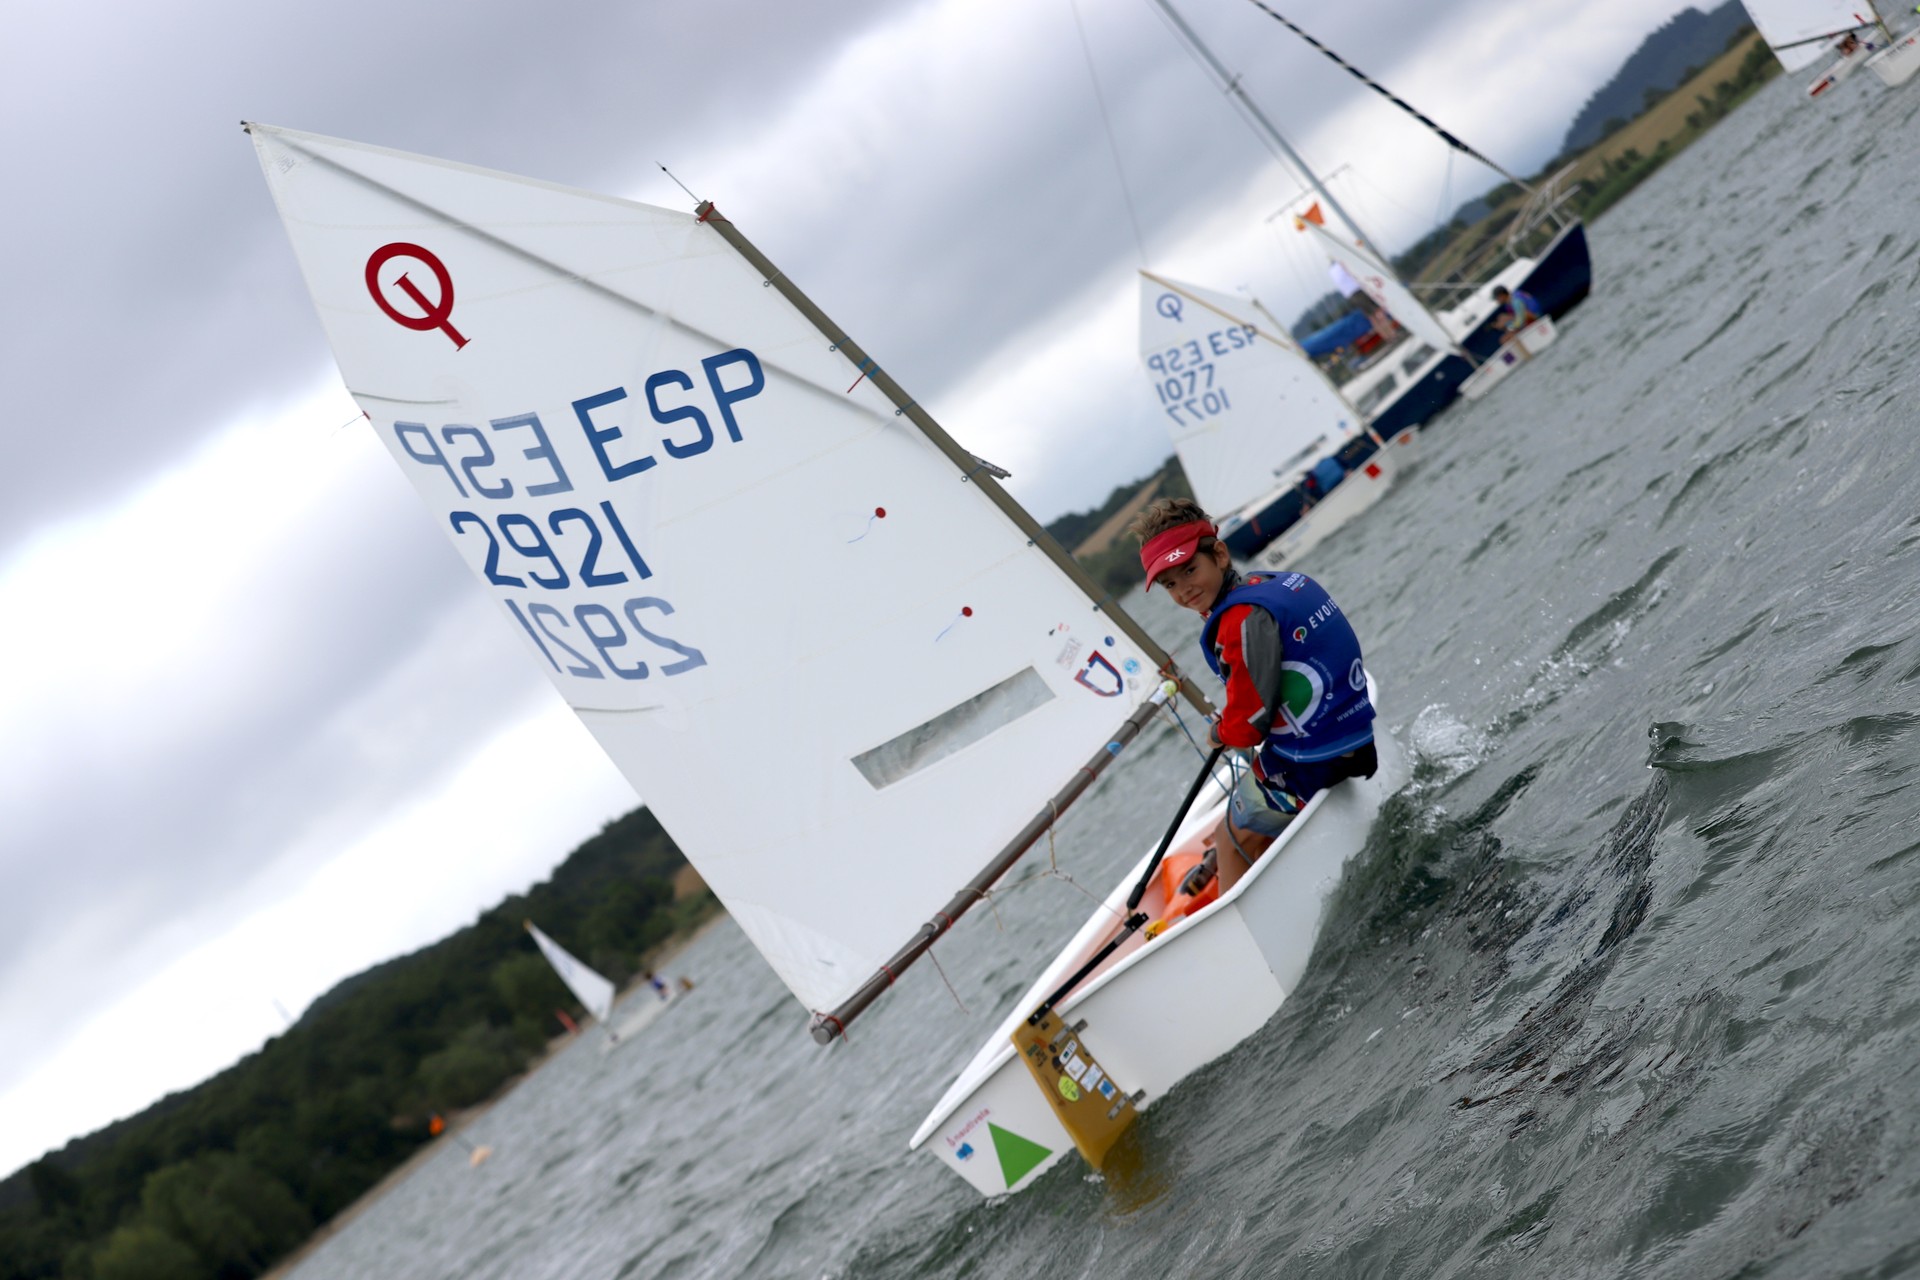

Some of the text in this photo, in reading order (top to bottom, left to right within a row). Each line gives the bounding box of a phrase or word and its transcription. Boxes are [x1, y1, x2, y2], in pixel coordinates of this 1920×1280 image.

[1208, 325, 1257, 356] ESP
[1155, 363, 1215, 405] 1077
[571, 348, 765, 482] ESP
[449, 500, 653, 590] 2921
[1165, 549, 1185, 562] ZK
